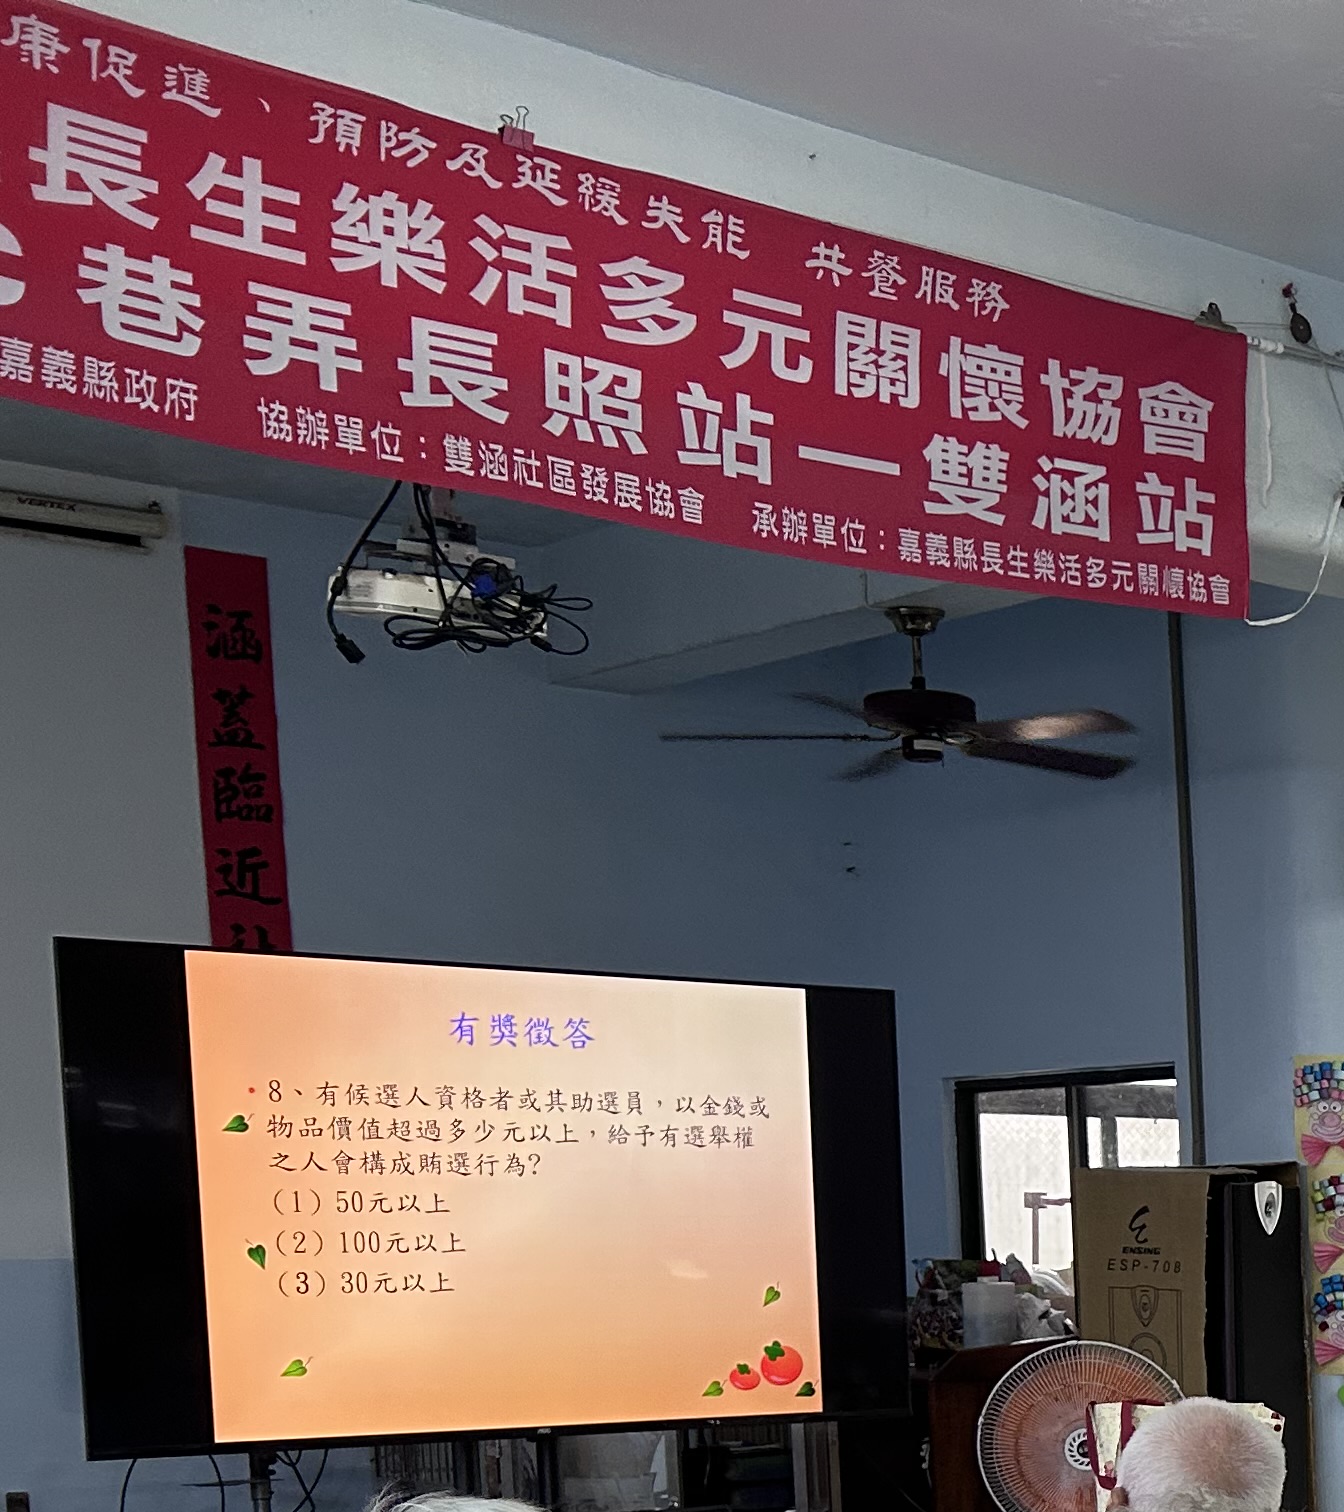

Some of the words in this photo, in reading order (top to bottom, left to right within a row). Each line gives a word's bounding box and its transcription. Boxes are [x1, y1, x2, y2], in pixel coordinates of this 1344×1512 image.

[28, 101, 1214, 462] 長生樂活多元關懷協會
[805, 241, 1010, 321] 共餐服務
[0, 336, 199, 421] 嘉義縣政府
[449, 1011, 595, 1049] 有獎徵答
